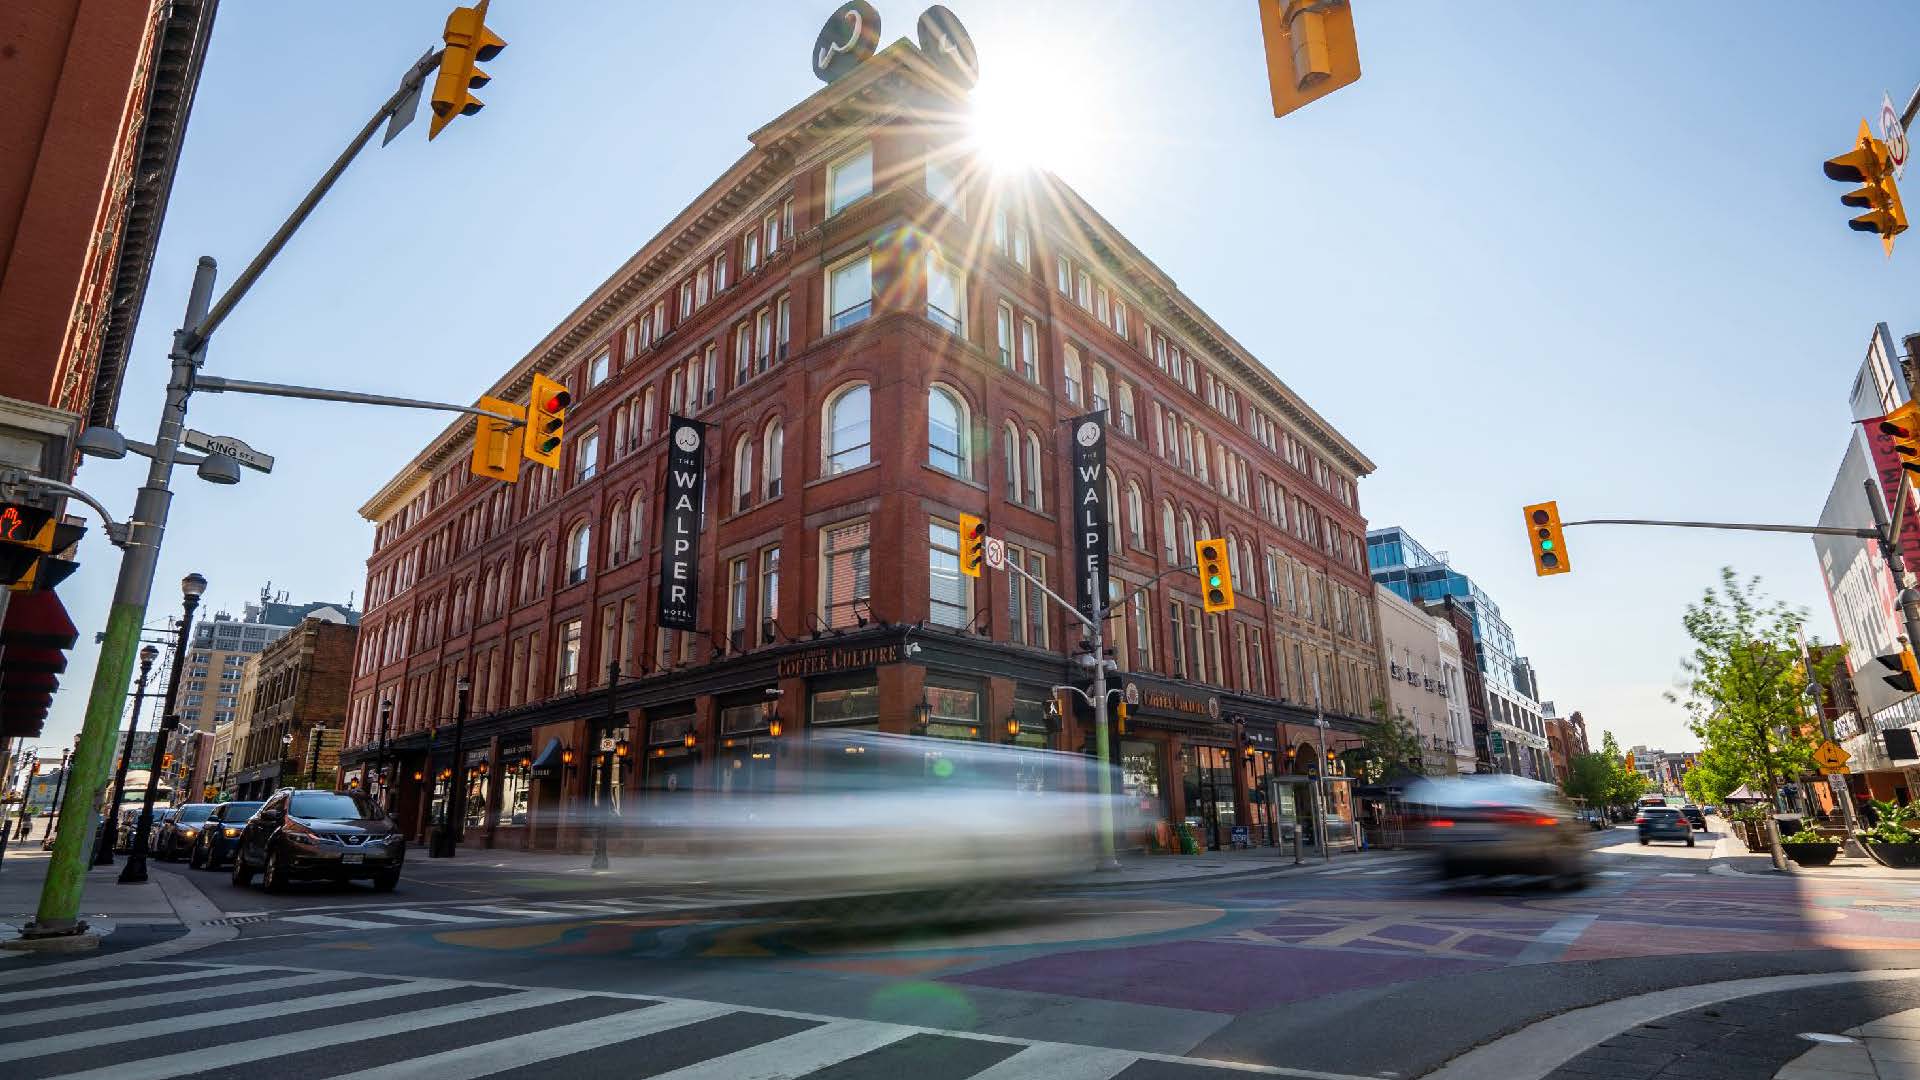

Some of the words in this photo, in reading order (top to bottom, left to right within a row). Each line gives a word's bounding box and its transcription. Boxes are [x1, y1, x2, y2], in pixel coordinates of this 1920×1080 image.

[206, 440, 237, 457] KING
[1083, 452, 1097, 460] THE
[679, 458, 695, 466] THE
[1079, 463, 1101, 595] WALPE
[671, 471, 697, 604] WALPER
[1081, 602, 1106, 610] HOL
[664, 608, 692, 618] HOTEL
